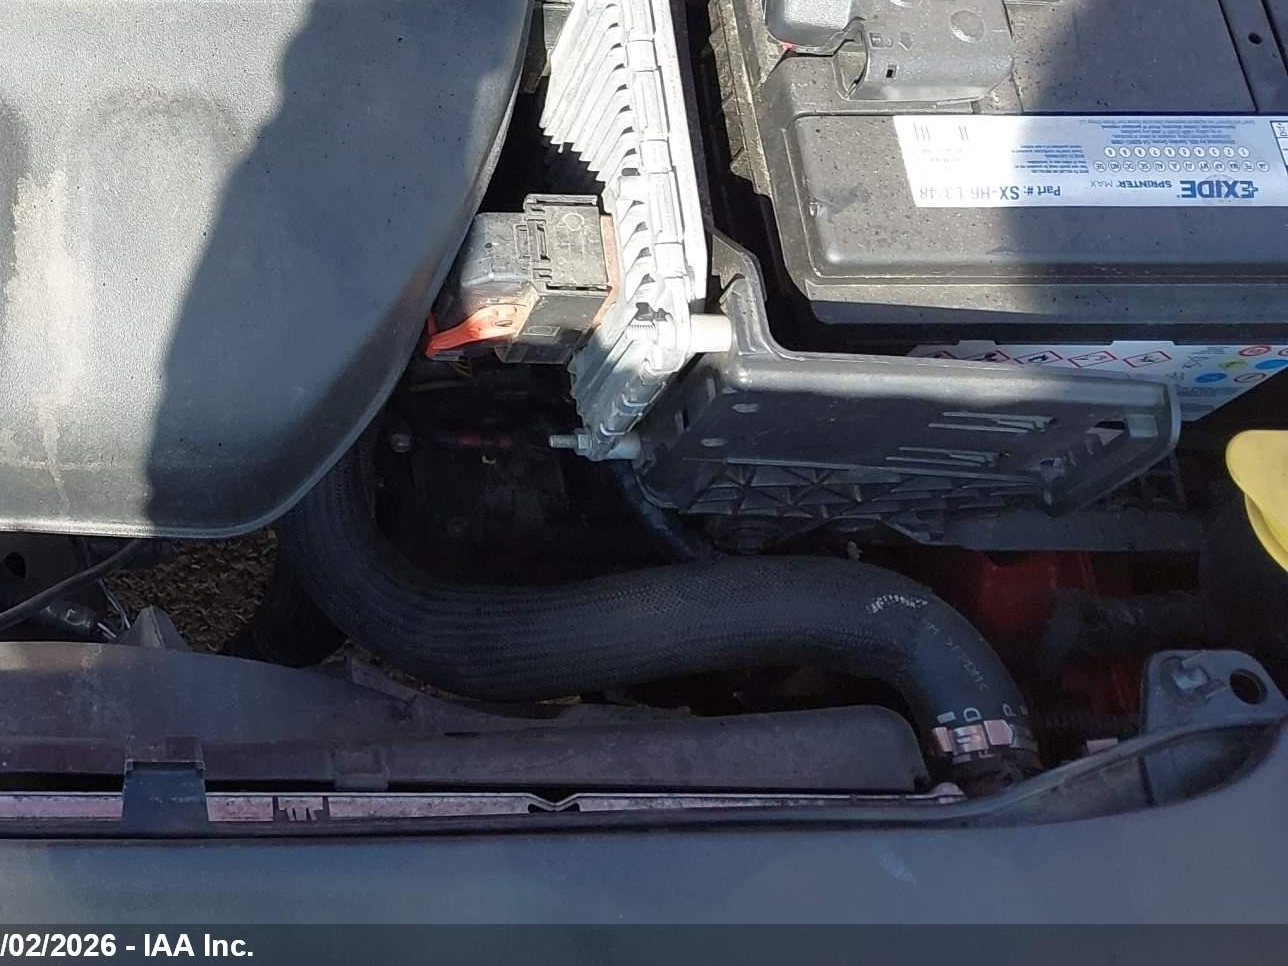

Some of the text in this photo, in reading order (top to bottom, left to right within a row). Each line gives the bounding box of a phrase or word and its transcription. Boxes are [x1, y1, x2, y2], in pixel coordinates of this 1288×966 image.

[1037, 185, 1061, 197] Part
[1089, 180, 1259, 199] EXIDE SPRINTER MAX
